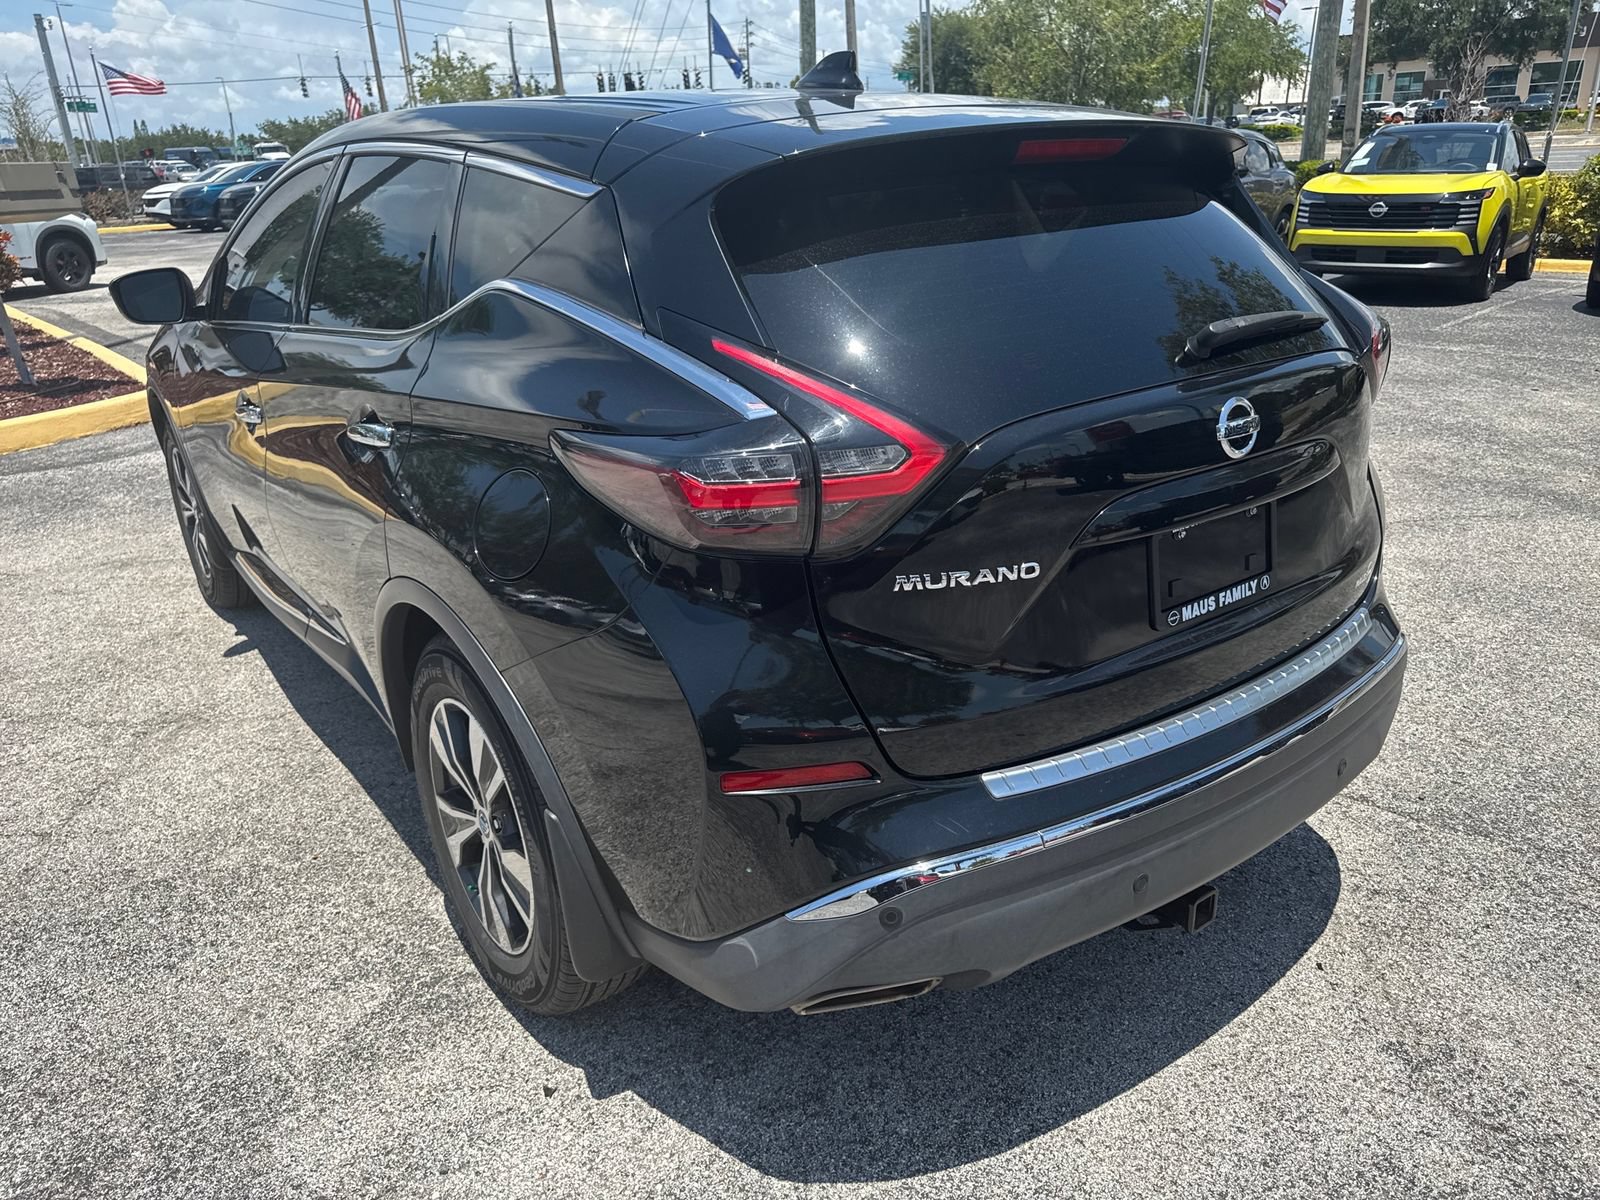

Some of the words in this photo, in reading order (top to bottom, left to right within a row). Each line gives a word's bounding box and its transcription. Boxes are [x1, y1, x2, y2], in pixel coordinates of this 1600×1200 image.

[1224, 417, 1259, 437] NISSAN
[893, 562, 1041, 592] MURANO
[1182, 596, 1216, 622] MAUS
[1219, 579, 1258, 608] FAMILY
